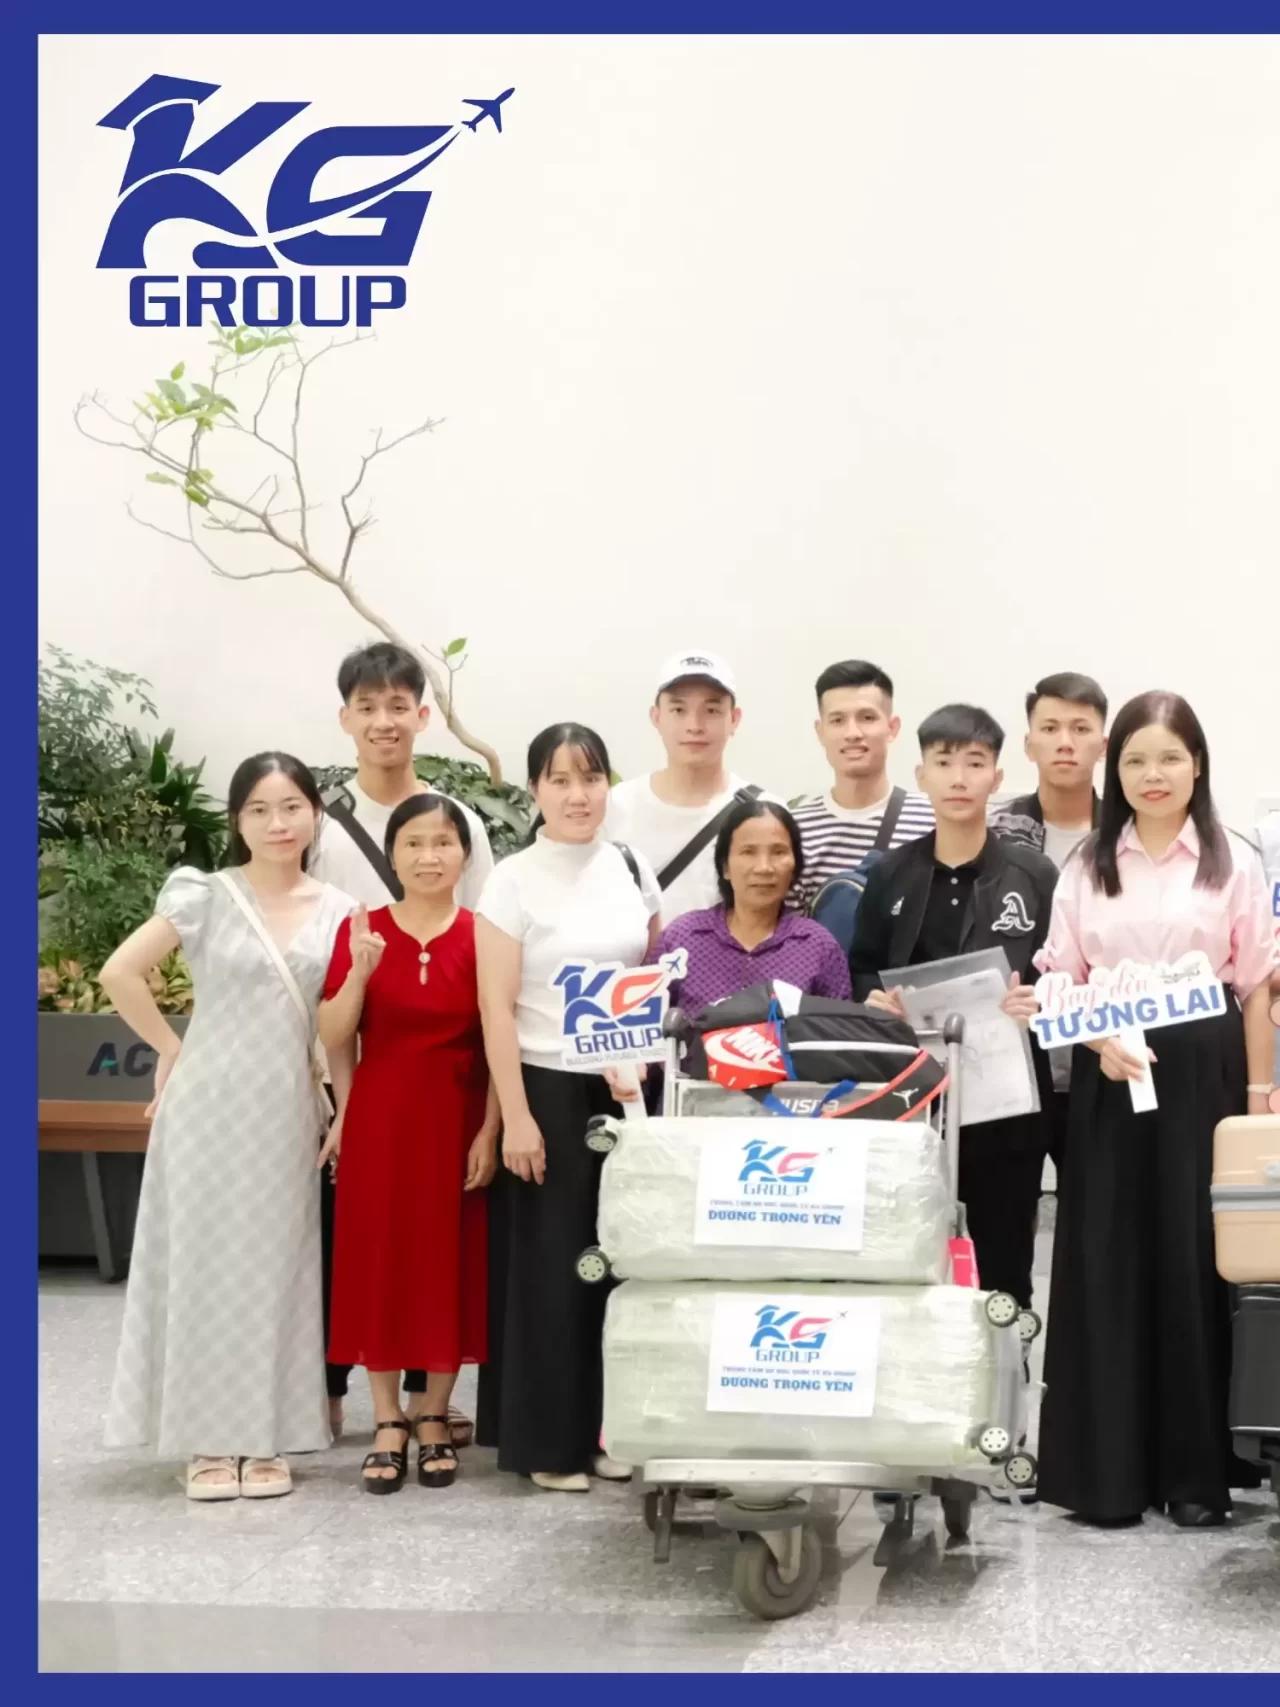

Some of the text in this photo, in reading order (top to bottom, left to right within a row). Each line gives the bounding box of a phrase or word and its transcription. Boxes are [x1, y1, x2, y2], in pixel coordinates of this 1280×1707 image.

[553, 965, 664, 1036] KG
[1165, 985, 1221, 1018] LAI
[574, 1027, 662, 1054] GROUP
[725, 1026, 782, 1069] NIKE
[738, 1139, 820, 1183] KG
[743, 1183, 808, 1197] GROUP
[750, 1304, 833, 1349] KG
[755, 1349, 820, 1363] GROUP
